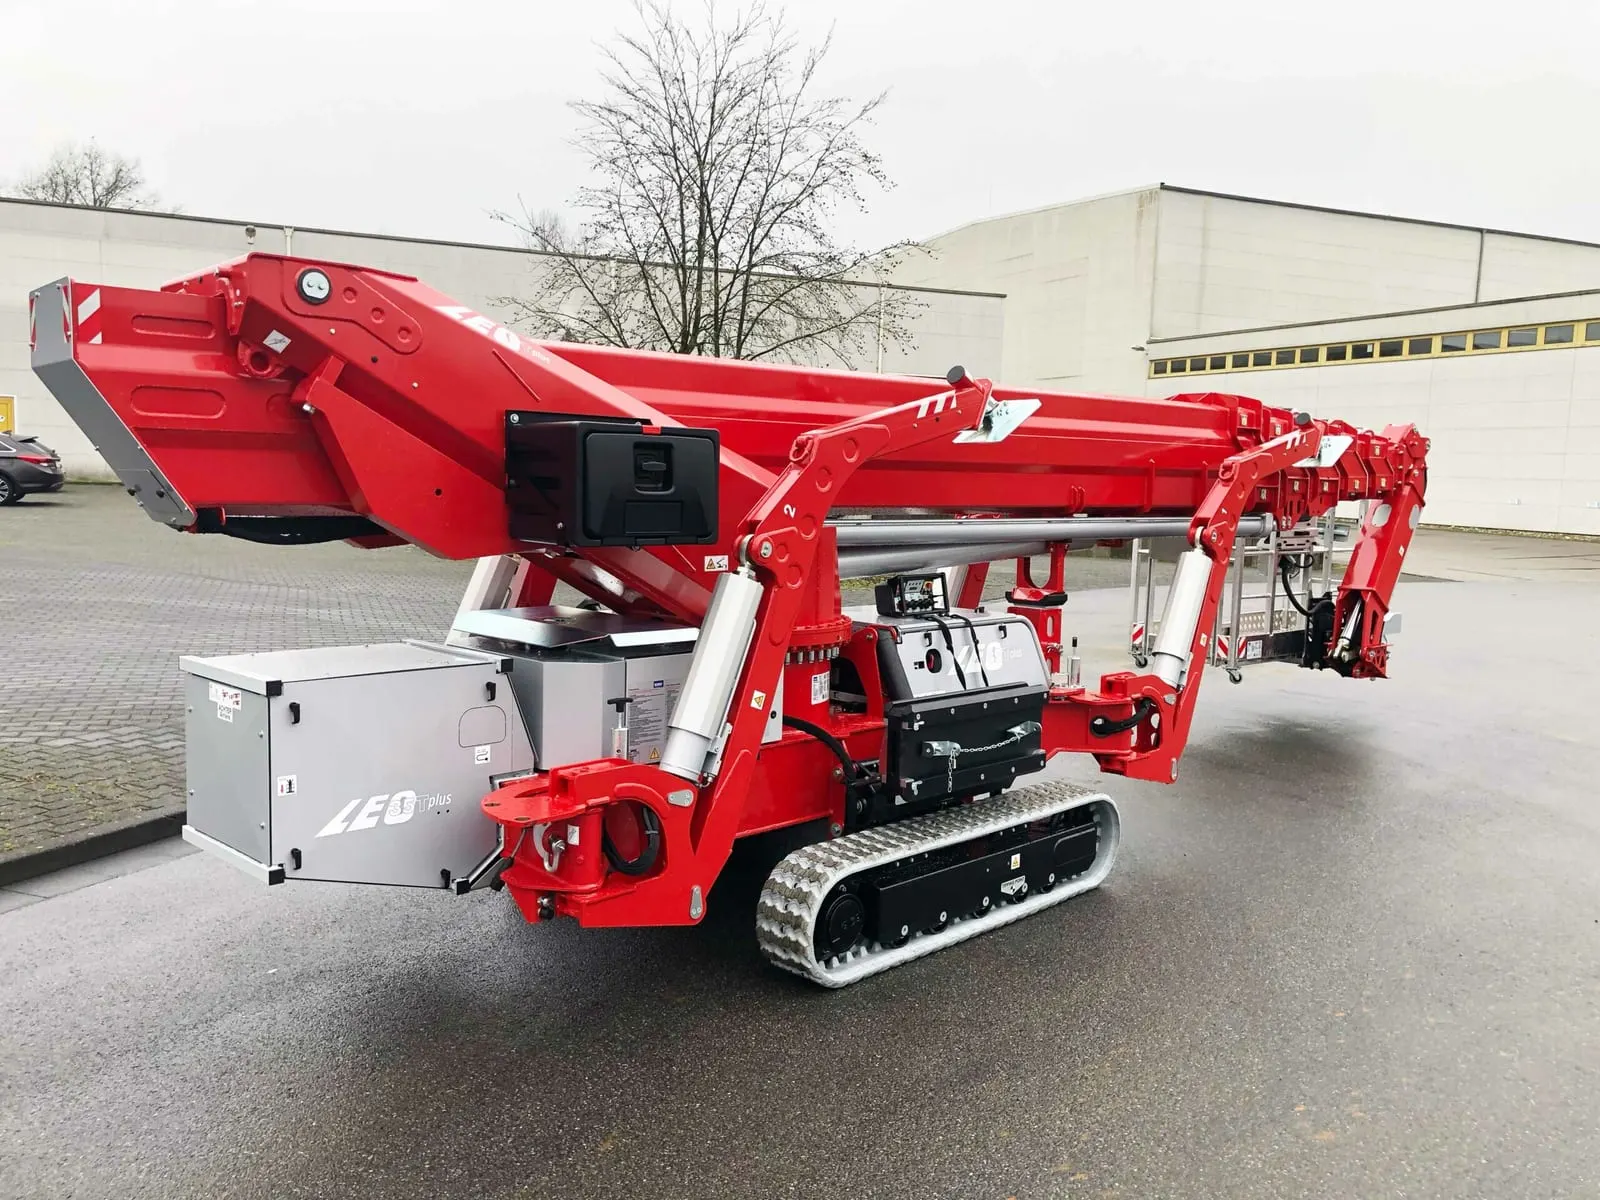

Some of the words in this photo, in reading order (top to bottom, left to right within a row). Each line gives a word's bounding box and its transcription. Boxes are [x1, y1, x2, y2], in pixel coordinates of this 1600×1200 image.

[433, 305, 521, 352] LEO
[783, 504, 796, 519] 2
[314, 790, 417, 838] LEO
[428, 793, 453, 810] plus
